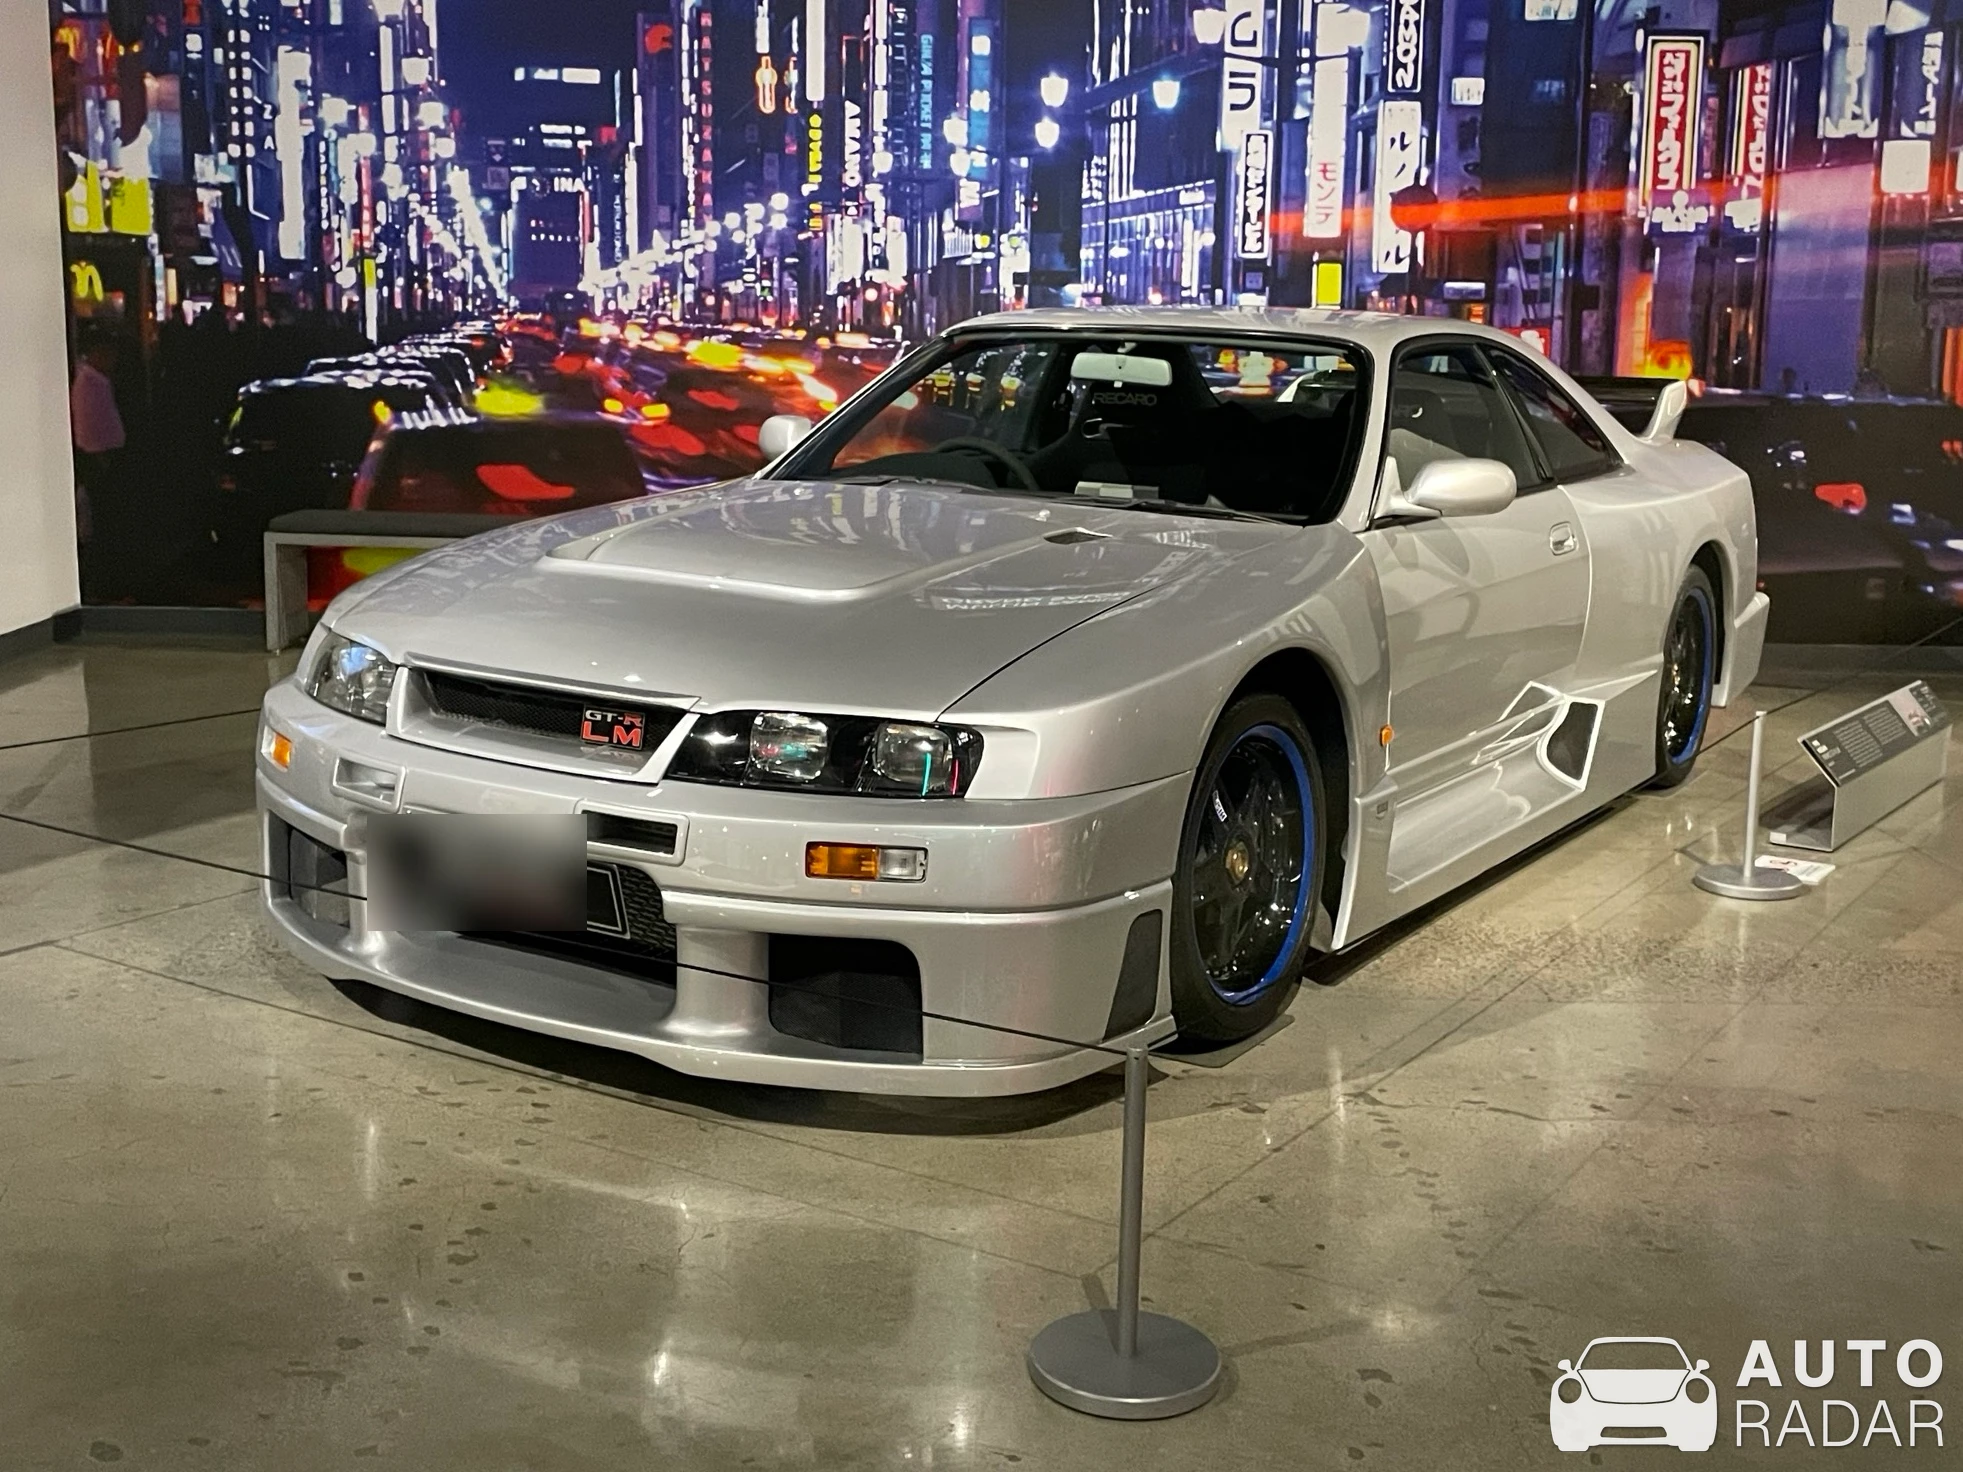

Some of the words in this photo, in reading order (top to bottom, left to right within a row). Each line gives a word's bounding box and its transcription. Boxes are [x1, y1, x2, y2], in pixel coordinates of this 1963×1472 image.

[1094, 392, 1158, 406] RECARO
[585, 709, 642, 727] GT-R
[582, 720, 642, 747] LM
